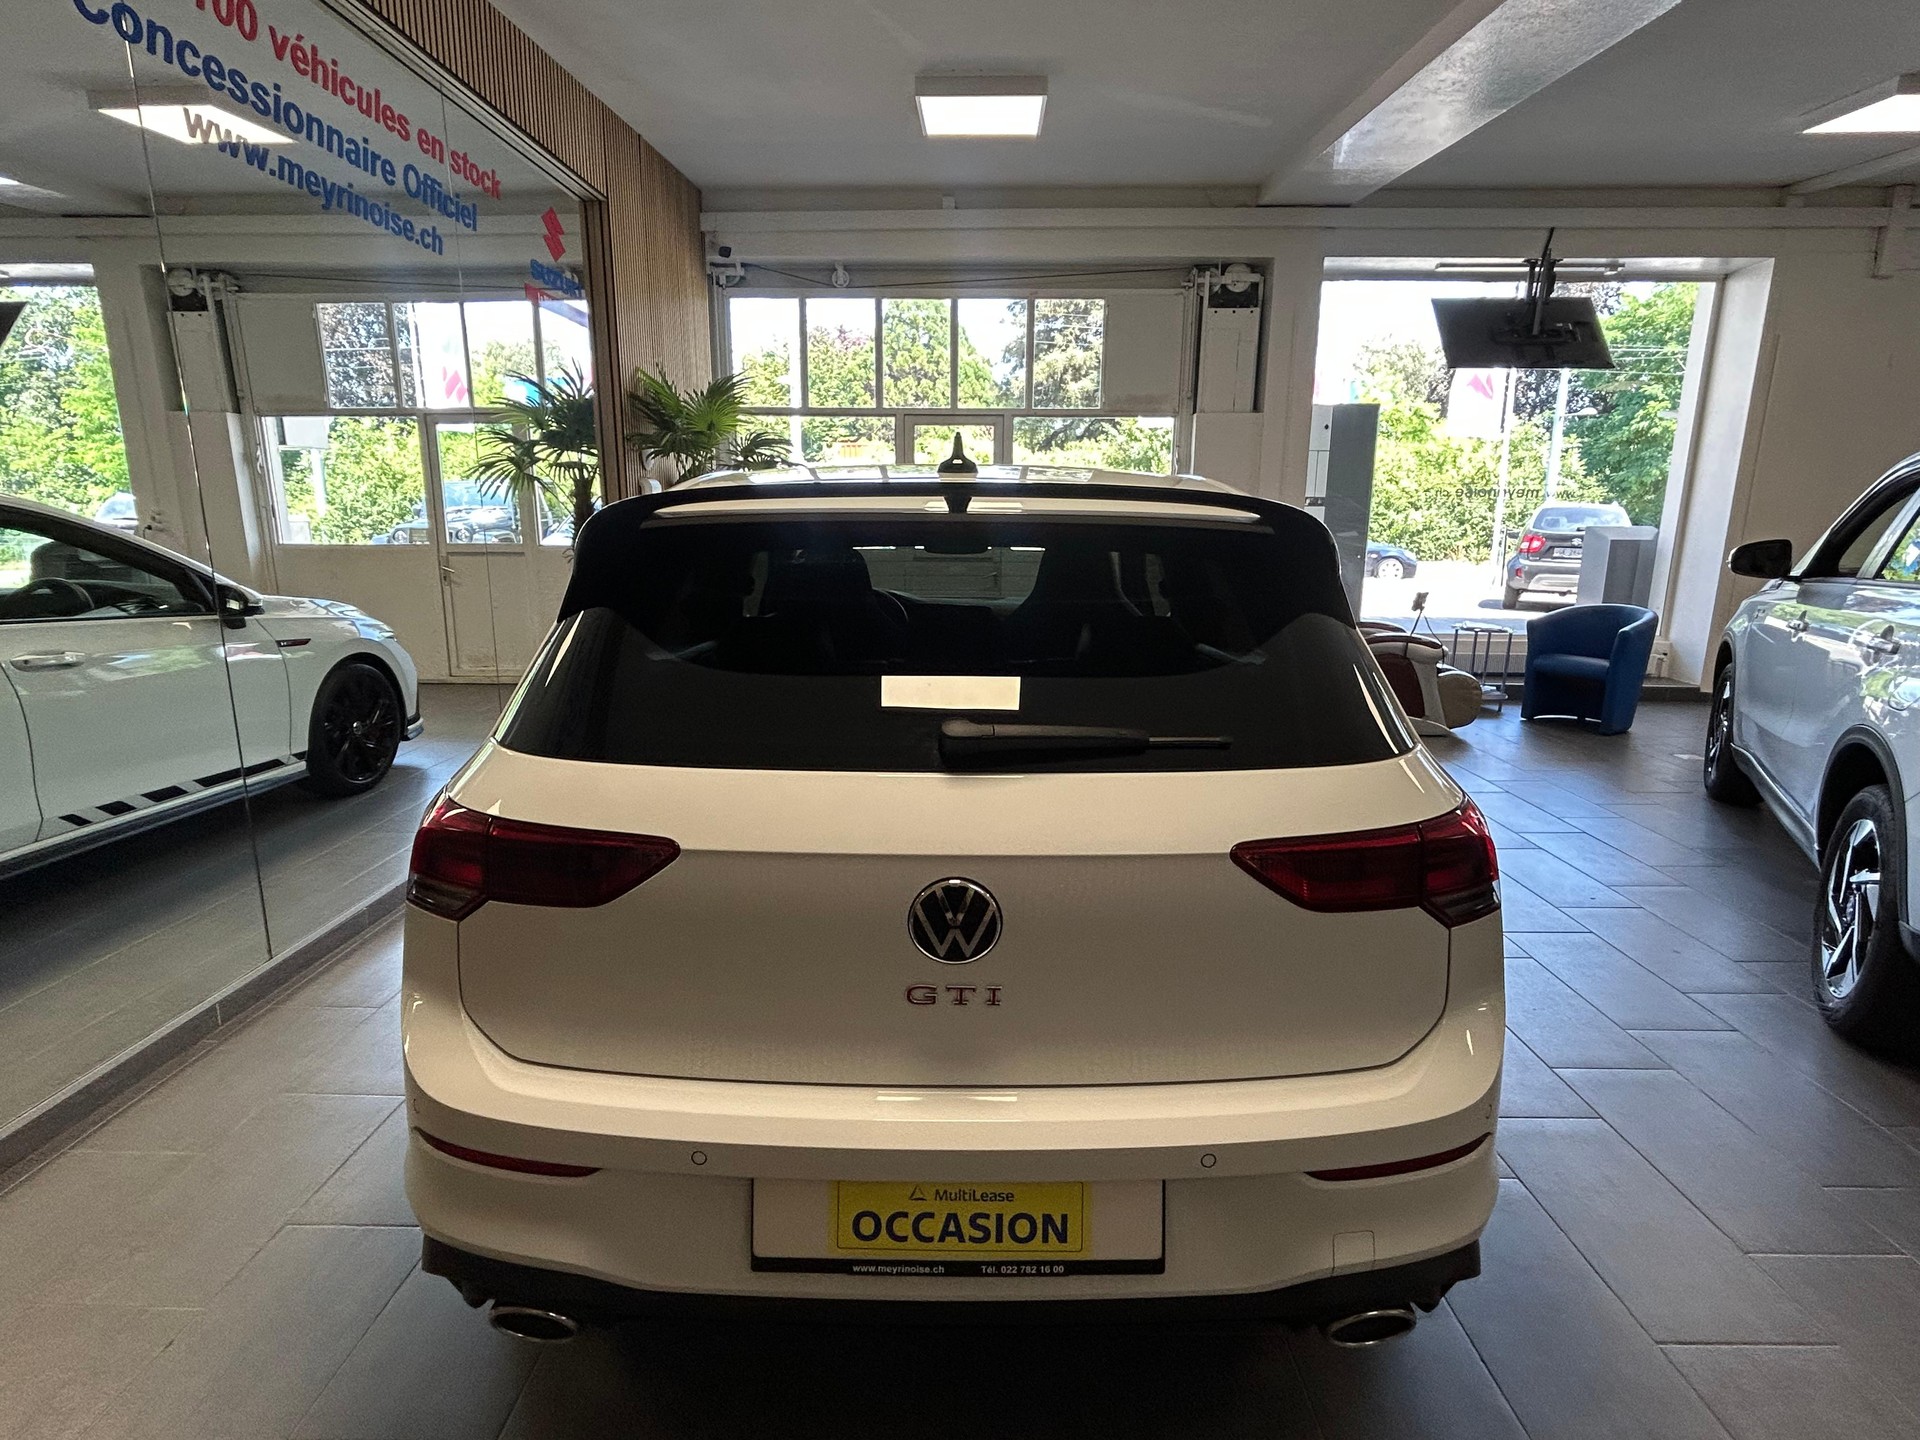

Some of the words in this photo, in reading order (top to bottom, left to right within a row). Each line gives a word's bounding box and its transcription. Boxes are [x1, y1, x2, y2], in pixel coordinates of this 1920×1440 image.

[195, 0, 258, 42] 00
[268, 24, 411, 142] véhicules
[417, 127, 445, 164] en
[450, 149, 501, 199] stock
[183, 107, 444, 256] www.meyrinoise.ch
[403, 163, 478, 232] Officiel
[906, 984, 1002, 1006] GTI
[933, 1187, 1015, 1203] MultiLease
[851, 1209, 1069, 1244] OCCASION
[852, 1264, 945, 1275] www.meyrinoise.ch
[981, 1264, 999, 1275] Tél.
[1000, 1265, 1018, 1275] 022
[1020, 1265, 1037, 1275] 782
[1052, 1265, 1065, 1274] 00
